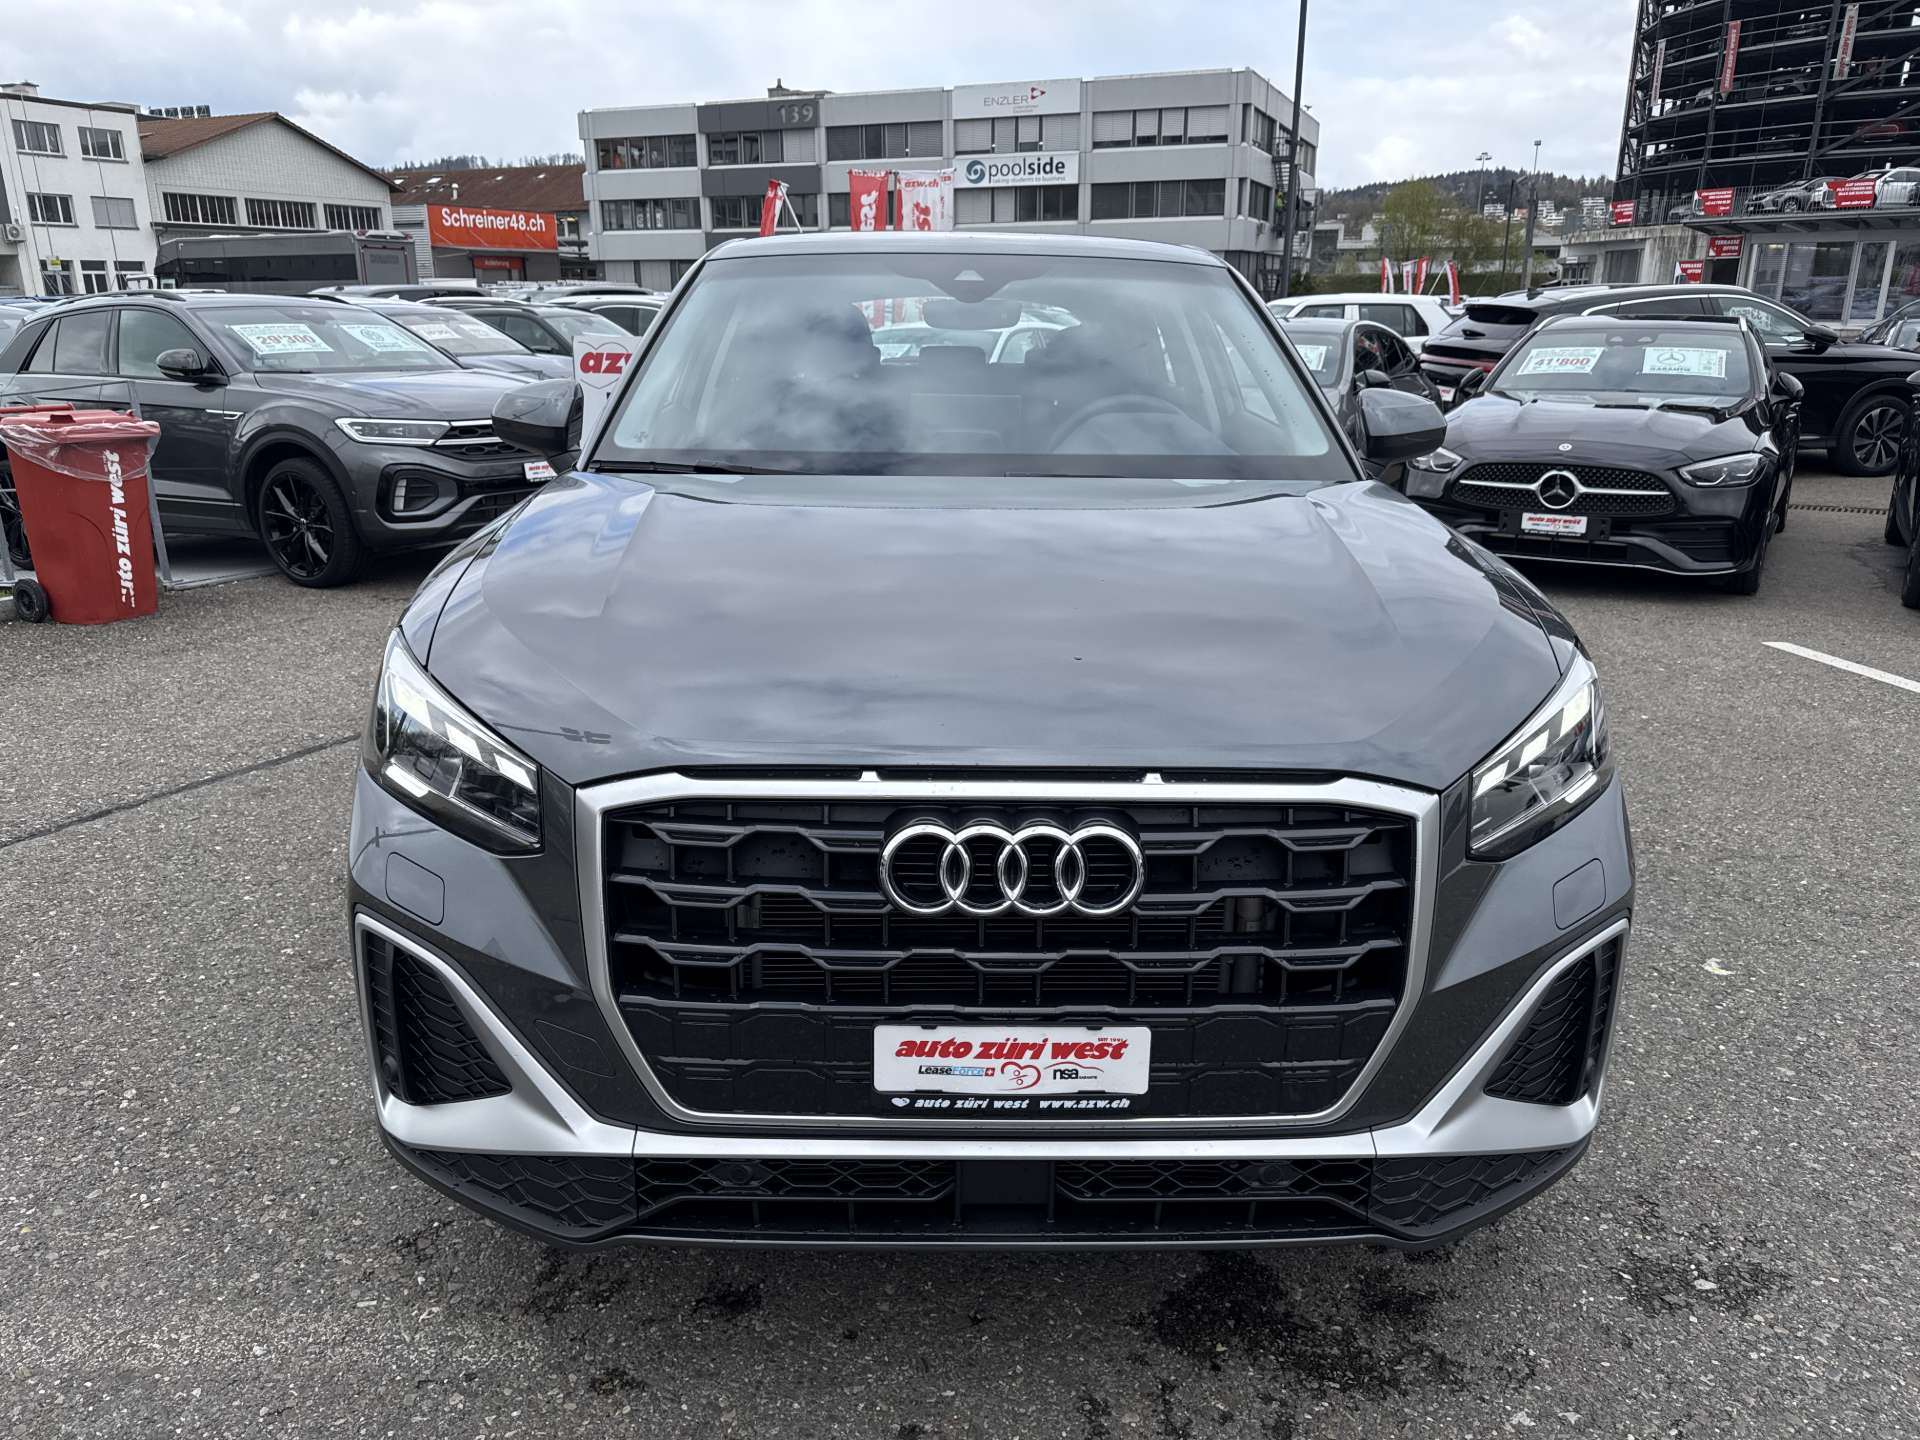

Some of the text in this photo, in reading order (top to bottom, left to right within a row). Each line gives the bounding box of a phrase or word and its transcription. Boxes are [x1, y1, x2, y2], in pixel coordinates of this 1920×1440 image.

[983, 95, 1029, 107] ENZLER
[778, 105, 814, 124] 139
[988, 156, 1066, 184] poolside
[441, 207, 546, 232] Schreiner48.ch
[103, 449, 126, 505] west
[108, 505, 132, 557] züri
[895, 1037, 1129, 1060] auto züri west
[918, 1065, 985, 1077] LeaseForce
[1053, 1067, 1079, 1080] nsa
[914, 1097, 1131, 1109] auto züri west www.azw.ch
